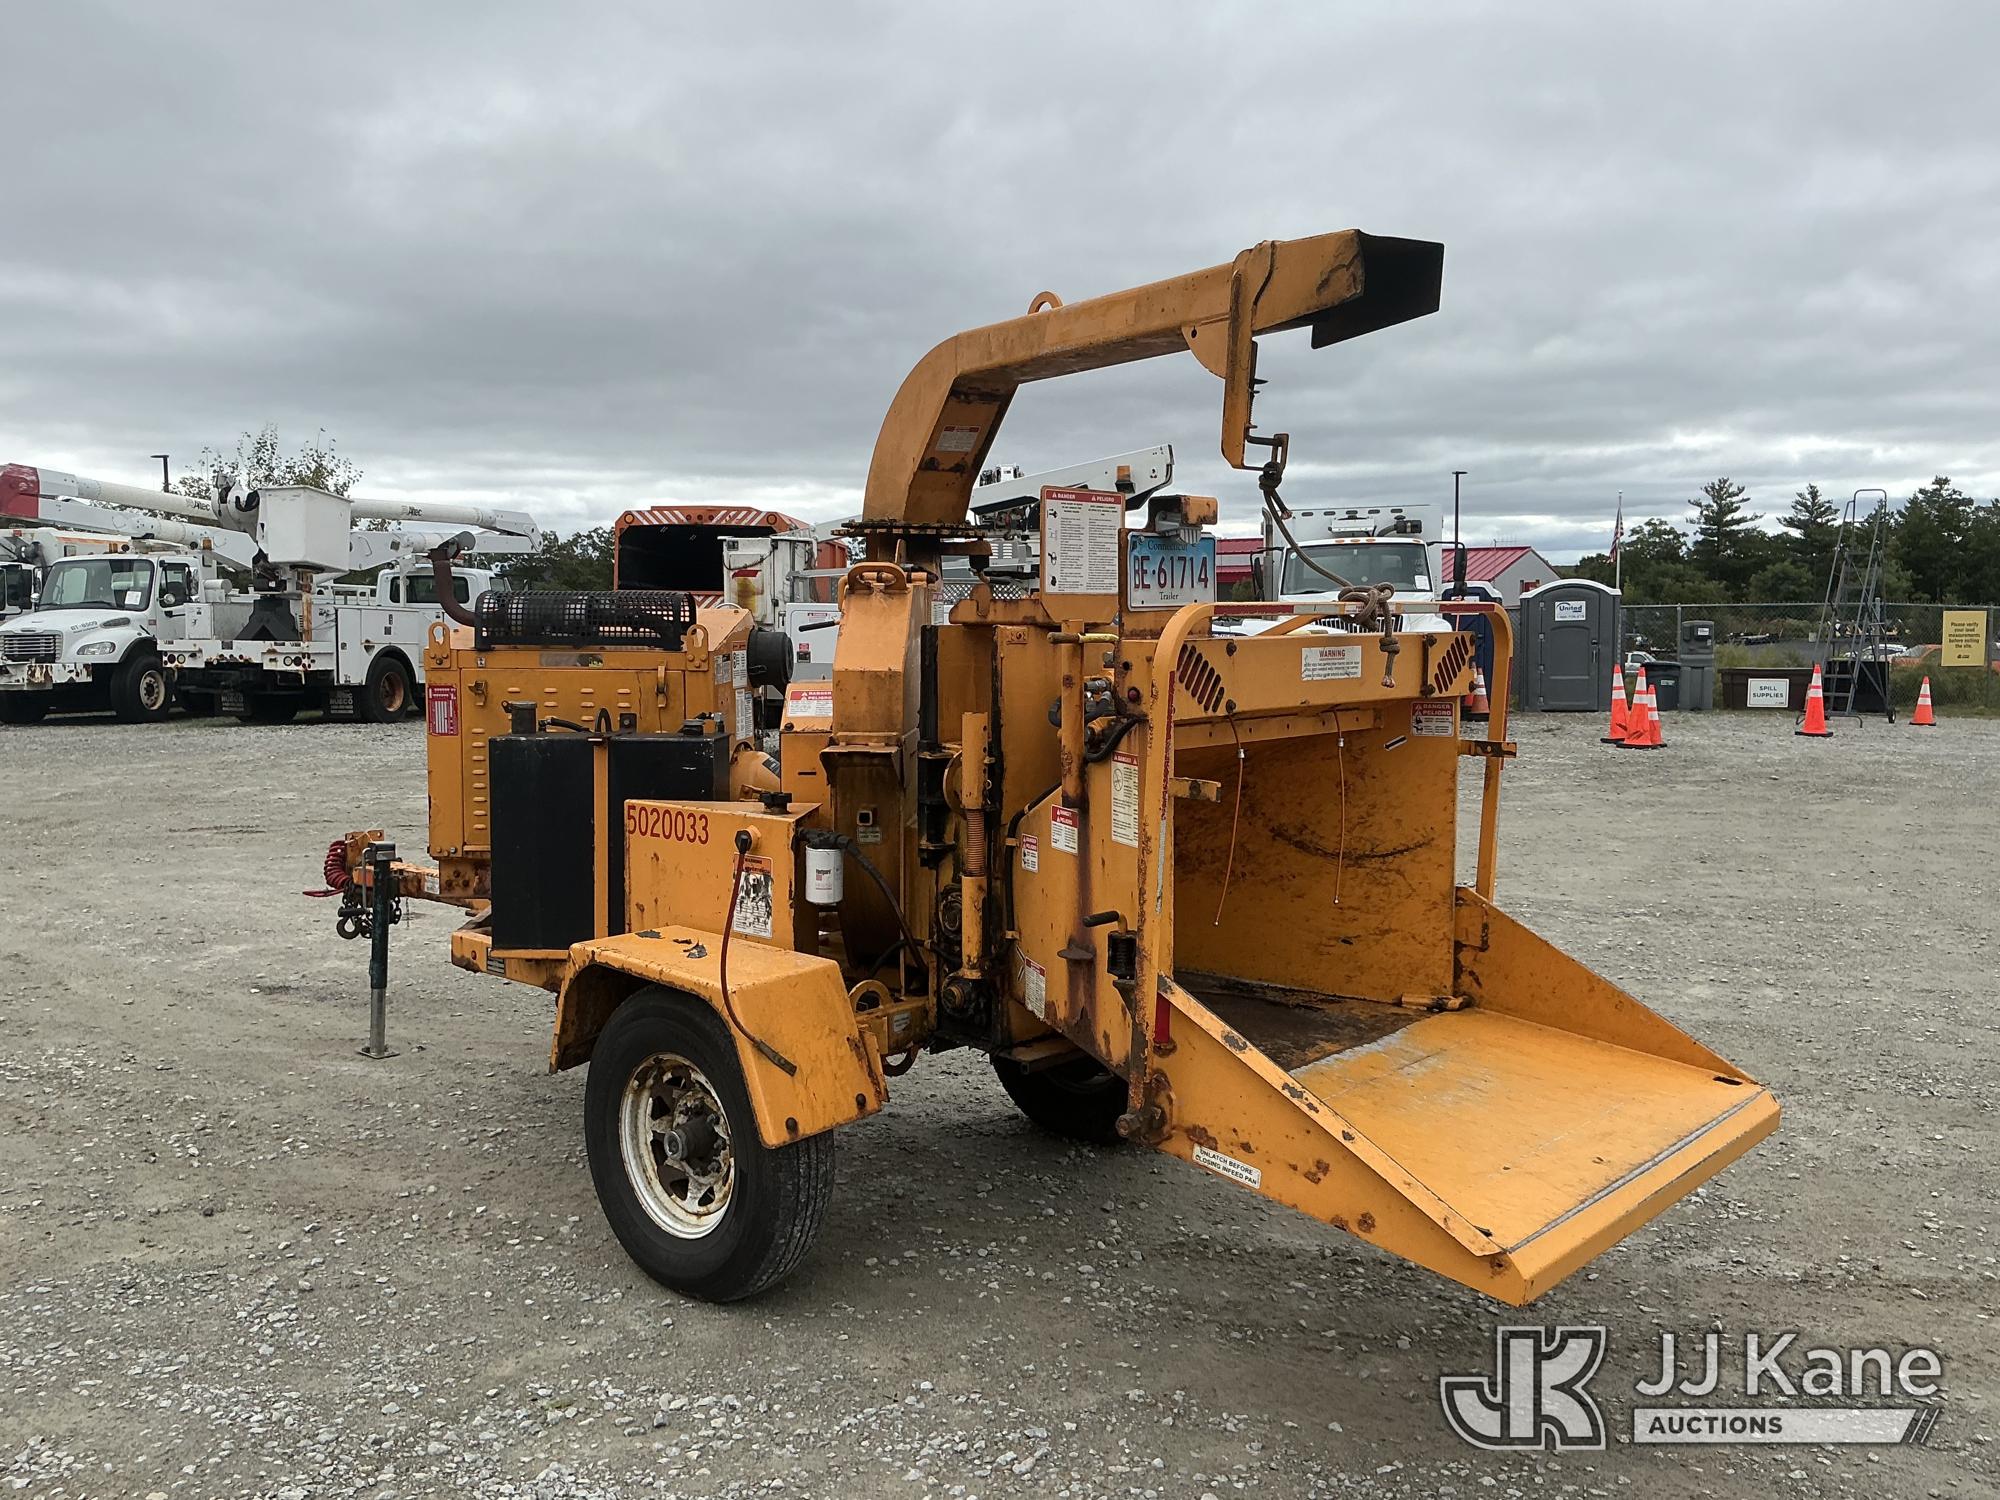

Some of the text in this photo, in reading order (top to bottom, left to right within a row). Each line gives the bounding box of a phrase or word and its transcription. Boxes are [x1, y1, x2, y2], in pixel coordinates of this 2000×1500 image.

[1159, 592, 1179, 600] Trailer
[1319, 649, 1346, 658] WARNING
[626, 804, 709, 845] 5020033
[1195, 1154, 1257, 1185] CLOSING INFEED PAN
[1200, 1149, 1254, 1176] UNLATCH BEFORE
